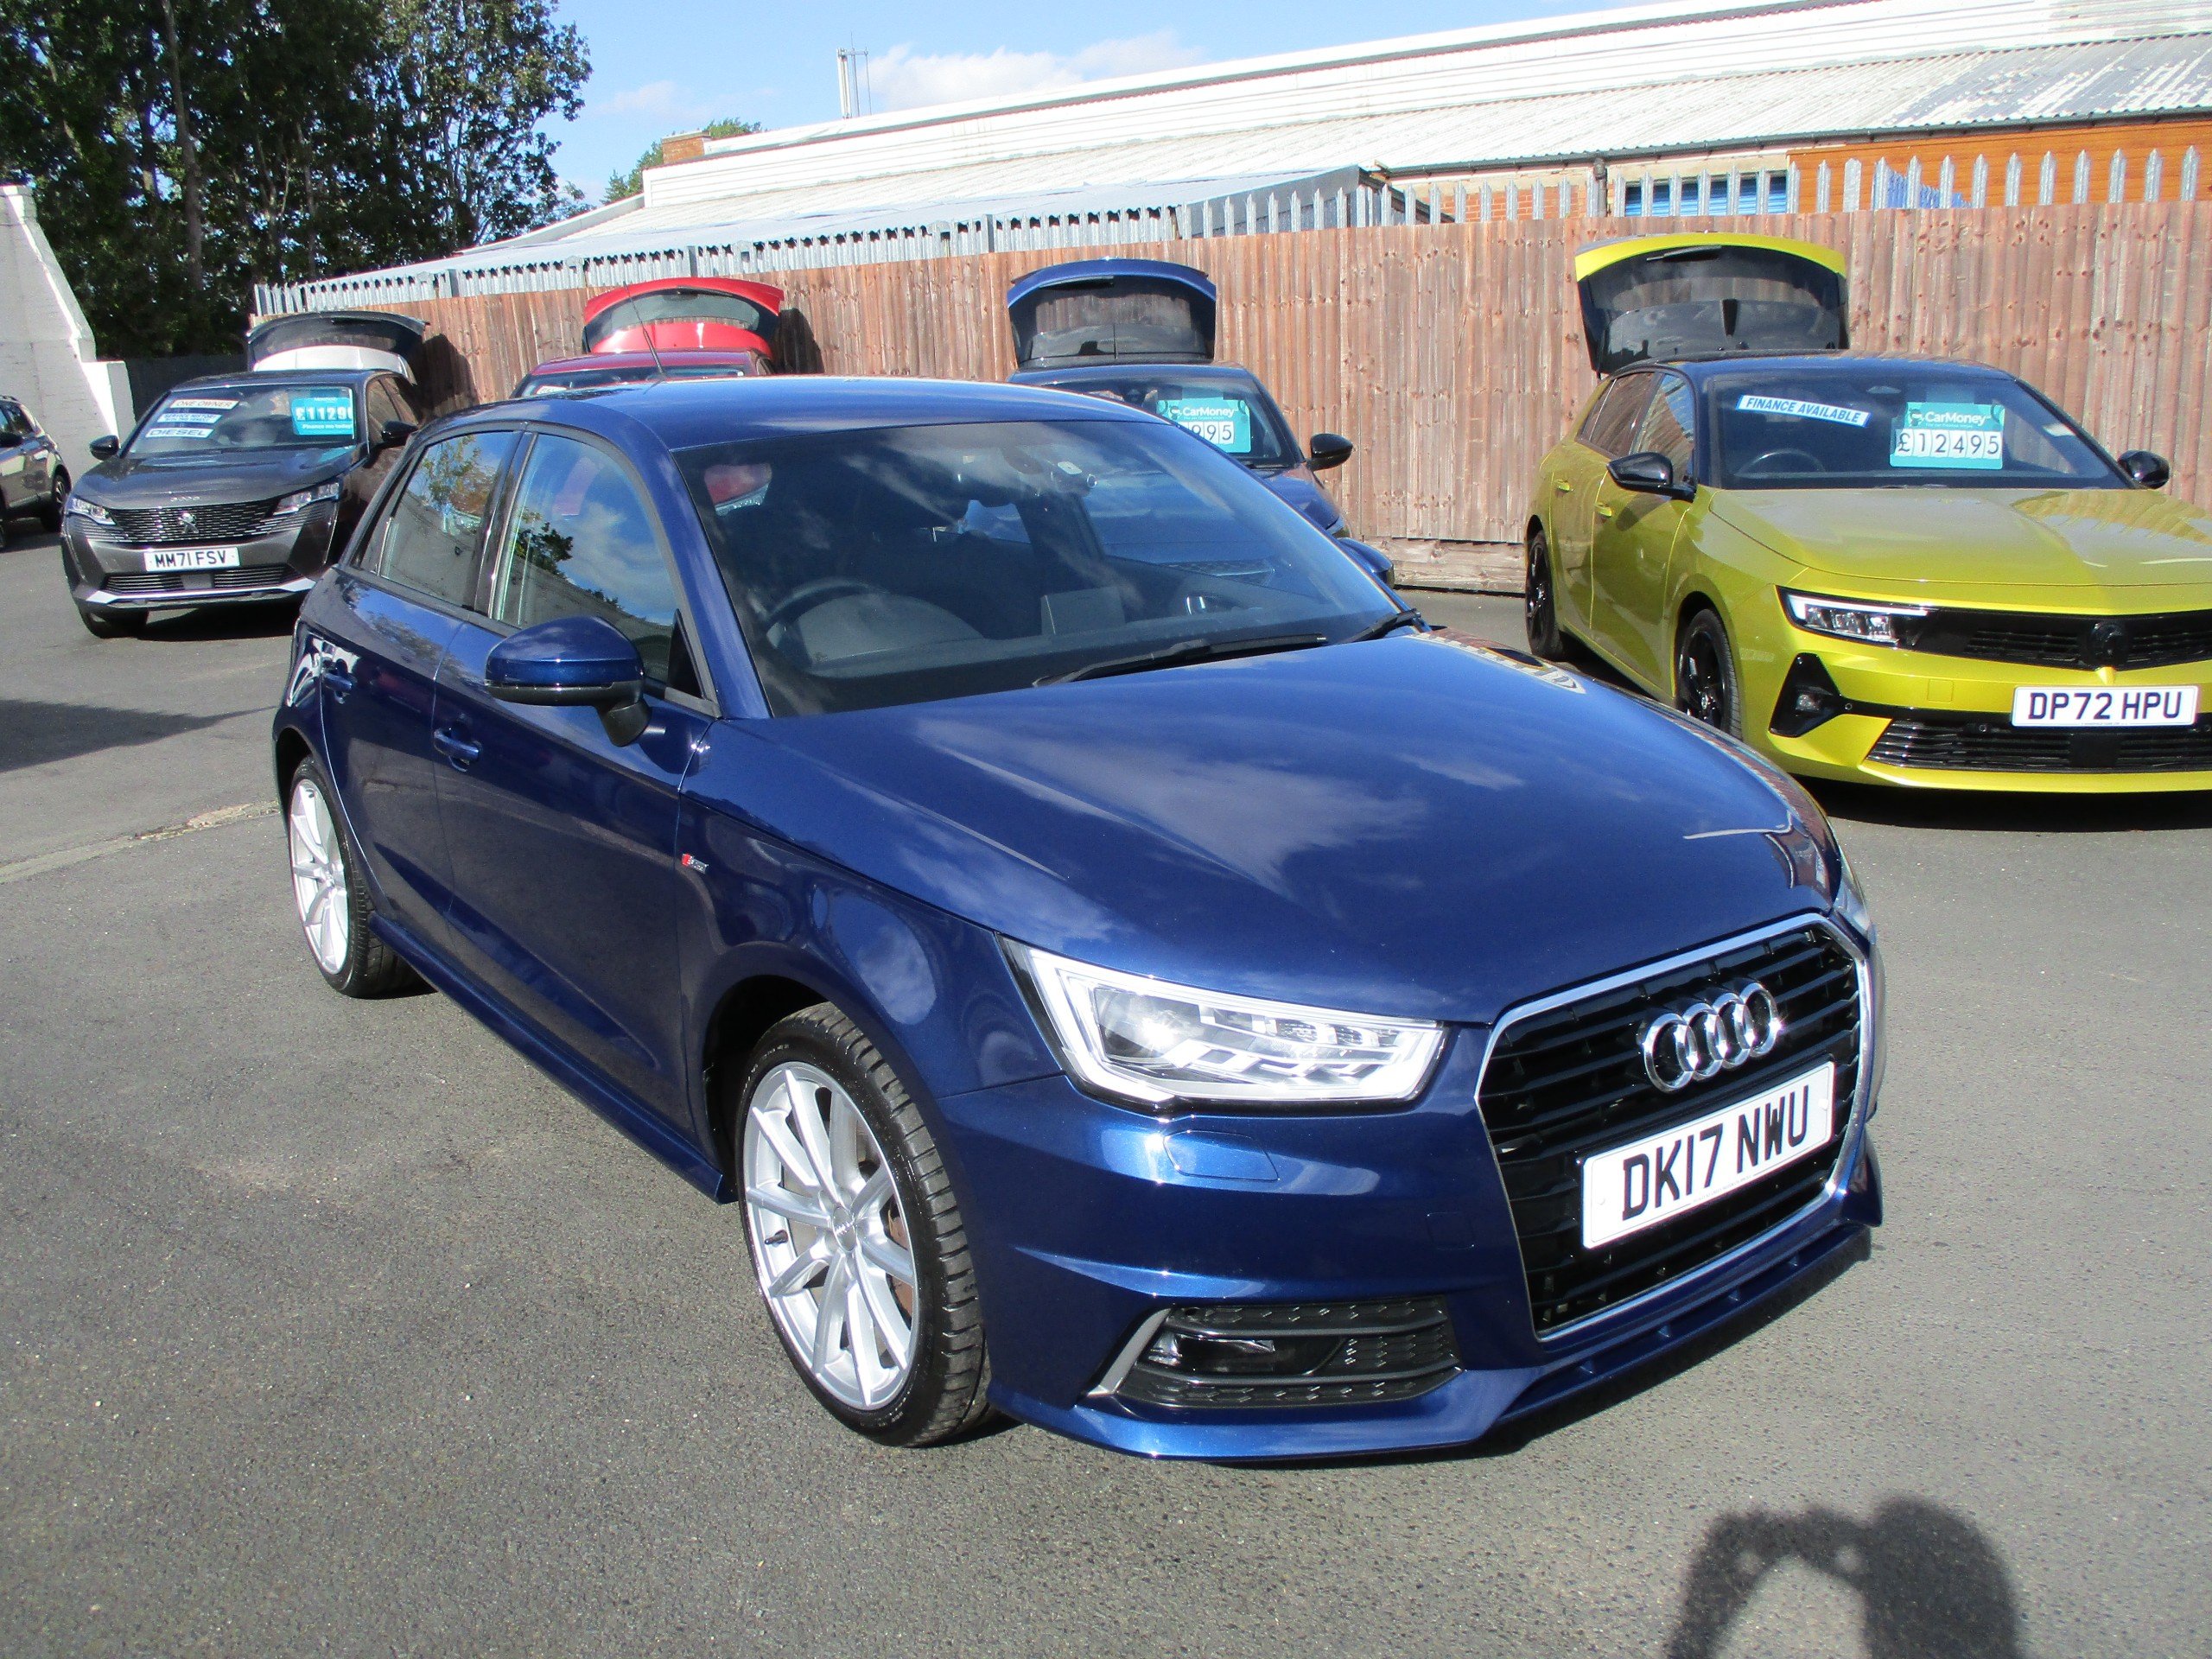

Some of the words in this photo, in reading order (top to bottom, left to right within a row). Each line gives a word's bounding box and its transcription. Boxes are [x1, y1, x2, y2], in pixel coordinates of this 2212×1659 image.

[1182, 406, 1235, 418] CarMoney
[1745, 397, 1796, 412] FINANCE
[1798, 404, 1861, 423] AVAILABLE
[1924, 411, 1986, 426] CarMoney
[1897, 432, 1999, 454] £12495
[154, 552, 192, 568] MM71
[194, 550, 226, 565] FSV
[2027, 691, 2113, 721] DP72
[2120, 691, 2183, 720] HPU
[1622, 1122, 1724, 1222] DK17
[1736, 1084, 1809, 1173] NWU
